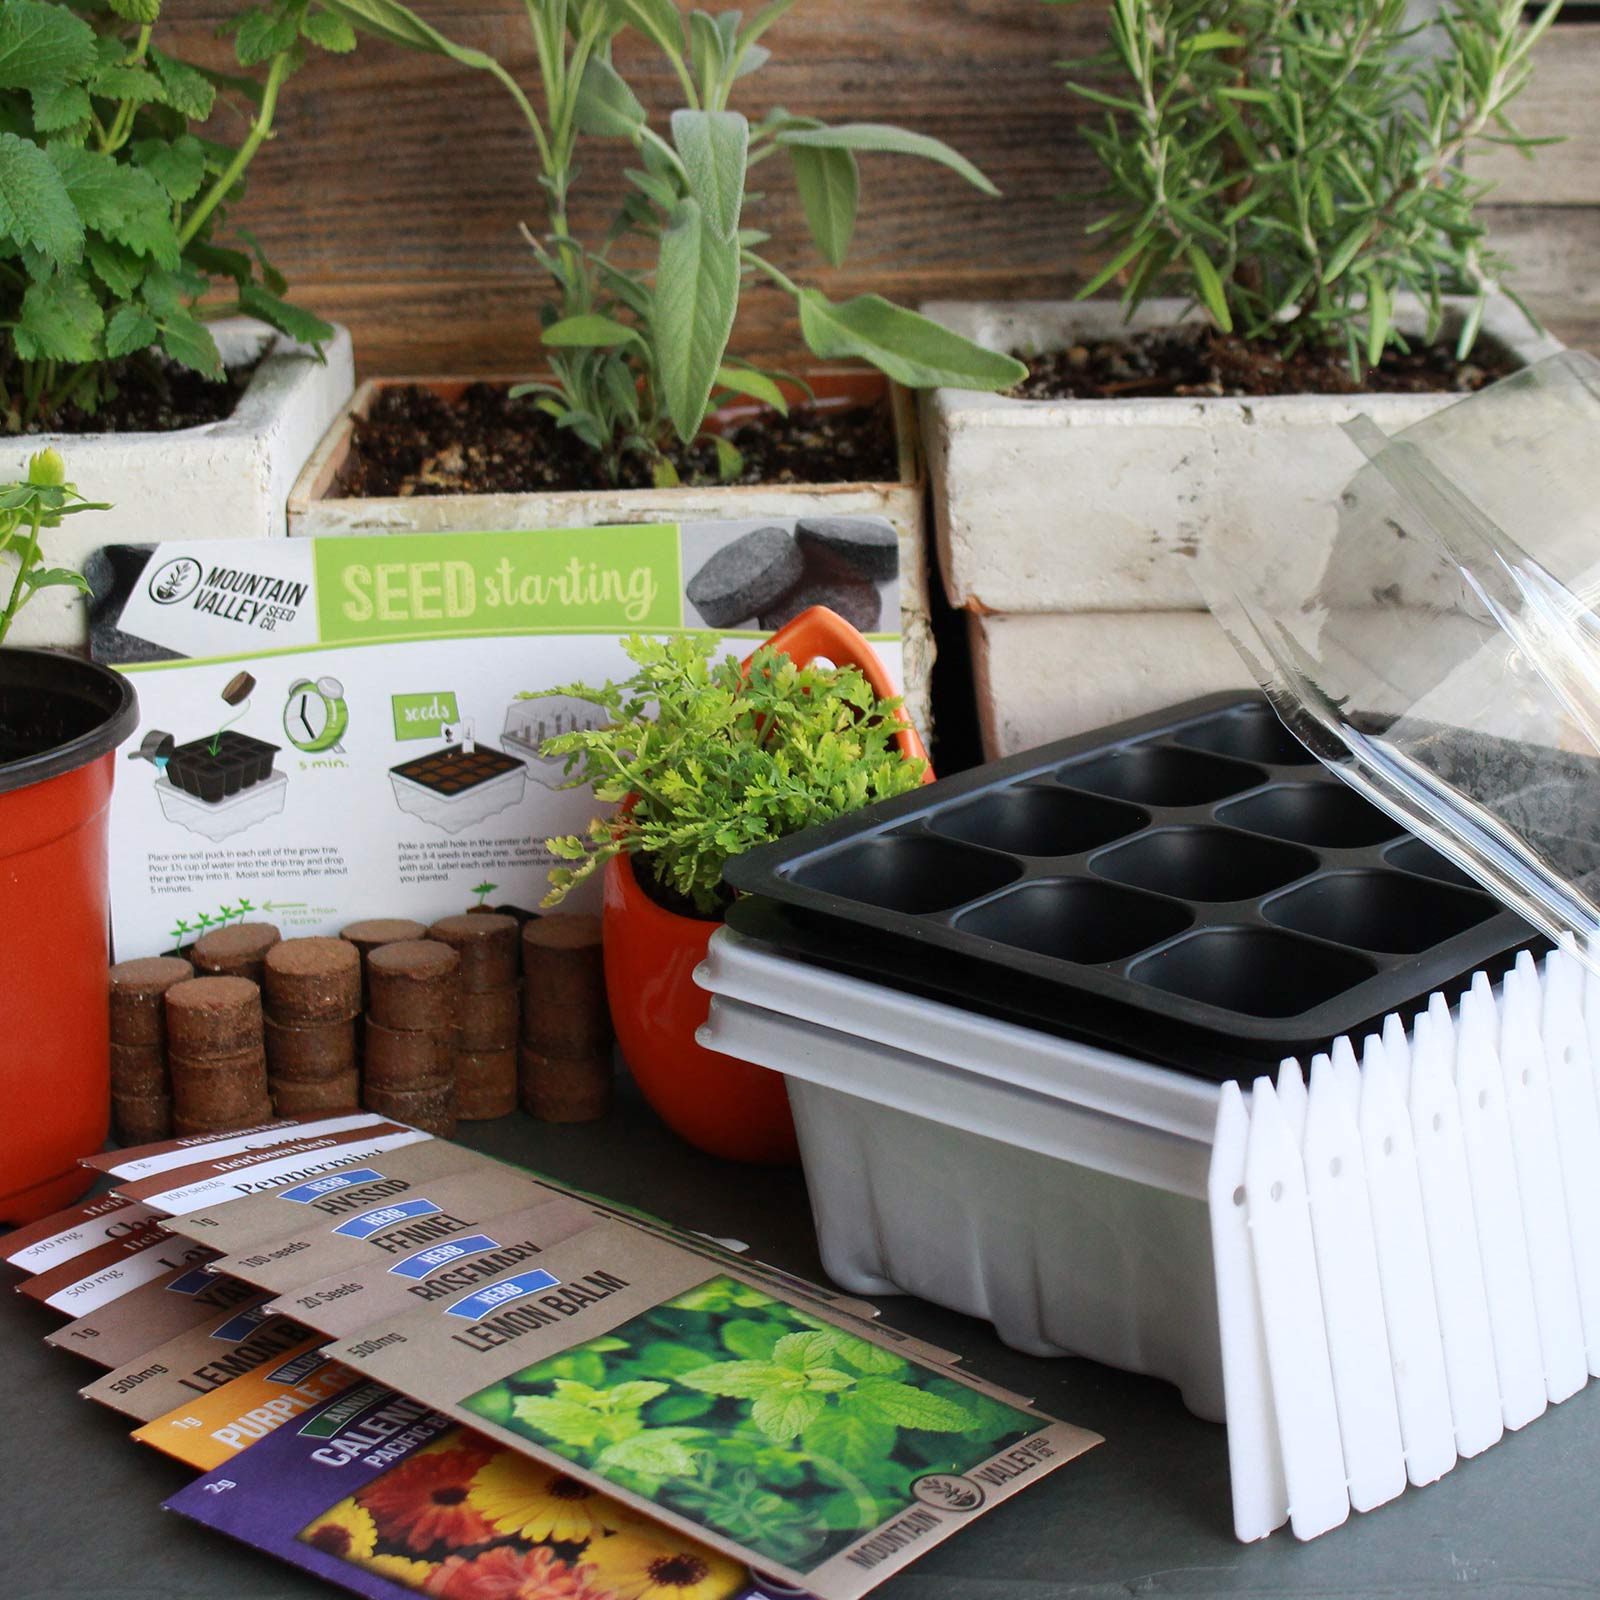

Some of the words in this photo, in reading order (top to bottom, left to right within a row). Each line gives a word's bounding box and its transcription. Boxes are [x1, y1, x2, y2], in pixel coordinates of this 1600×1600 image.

[204, 566, 308, 608] MOUNTAIN
[341, 560, 477, 621] SEED
[484, 556, 658, 622] starting
[193, 589, 268, 626] VALLEY
[265, 604, 297, 623] SEED
[404, 696, 450, 723] seeds
[311, 757, 350, 770] min.
[284, 847, 298, 856] the
[299, 847, 320, 857] grow
[255, 858, 271, 868] the
[306, 857, 323, 866] and
[437, 861, 459, 871] Label
[150, 875, 165, 884] the
[236, 870, 260, 879] Moist
[211, 1146, 296, 1172] Heirloom
[293, 1138, 338, 1152] Herb
[190, 1179, 226, 1197] seeds
[305, 1176, 352, 1193] HERB
[190, 1216, 219, 1229] 1g
[360, 1208, 409, 1227] HERB
[26, 1240, 56, 1257] 500
[238, 1254, 272, 1268] 100
[268, 1240, 312, 1259] seeds
[416, 1244, 466, 1265] HERB
[66, 1280, 96, 1299] 500
[296, 1296, 323, 1310] 20
[314, 1282, 365, 1302] Seeds
[474, 1282, 524, 1307] HERB
[451, 1295, 562, 1354] LEMON
[540, 1269, 631, 1317] BALM
[70, 1326, 101, 1341] 1g
[346, 1329, 408, 1359] 500mg
[178, 1336, 282, 1395] LEMON
[108, 1362, 169, 1395] 500mg
[171, 1415, 205, 1431] 1g
[361, 1424, 435, 1469] PACIFIC
[202, 1477, 237, 1495] 2g
[846, 1507, 943, 1570] MOUNTAIN
[973, 1446, 1044, 1487] VALLEY
